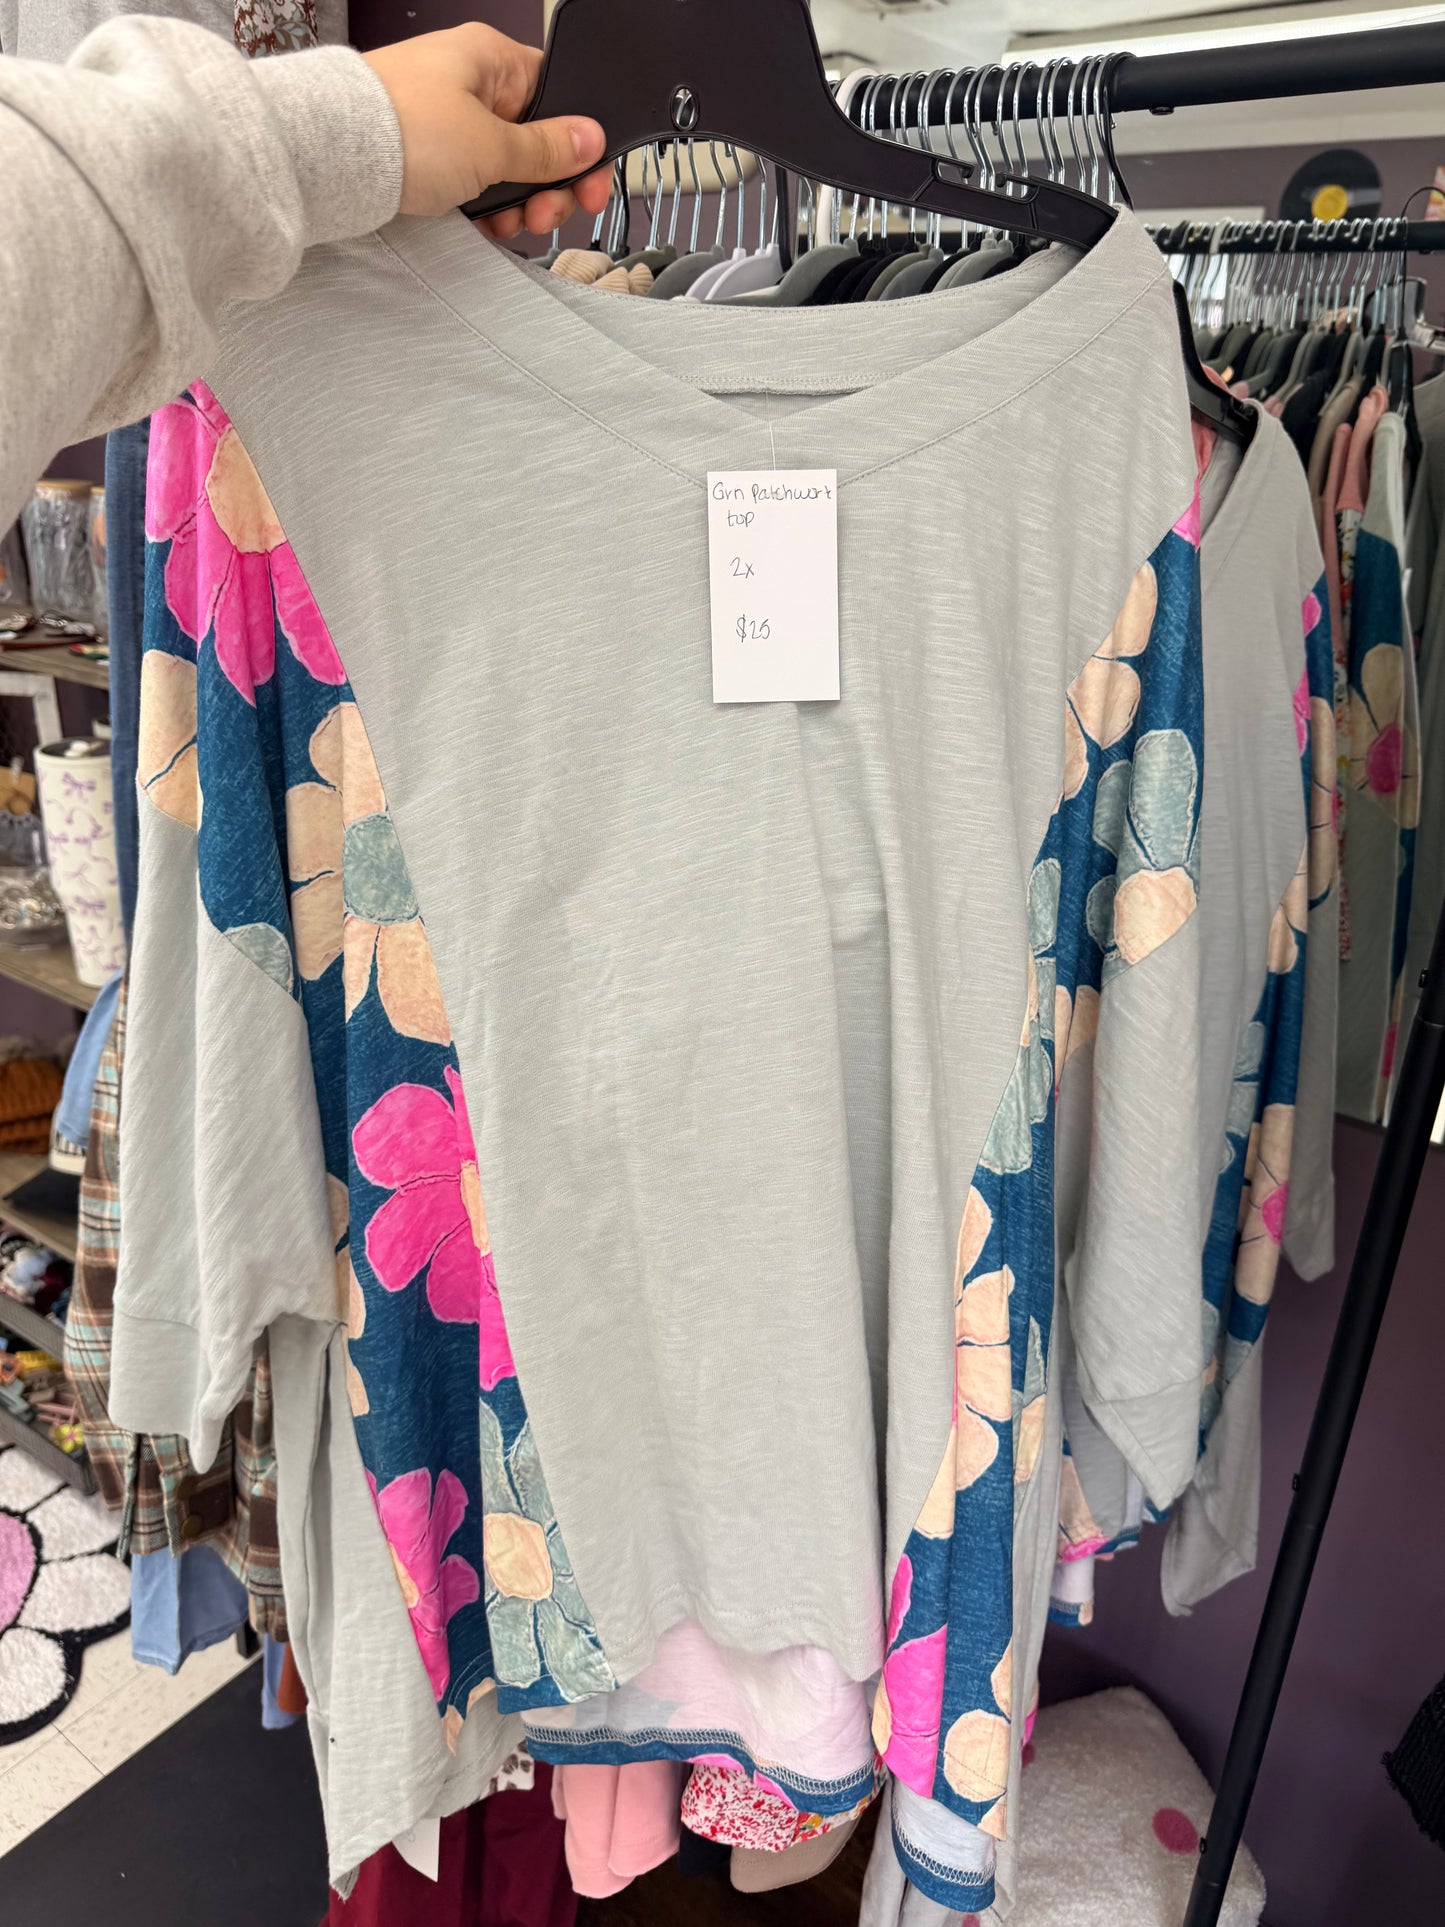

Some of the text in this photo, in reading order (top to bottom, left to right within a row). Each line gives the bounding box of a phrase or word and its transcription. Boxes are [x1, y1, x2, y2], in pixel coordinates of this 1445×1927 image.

[712, 481, 745, 501] Grn
[727, 510, 755, 528] top
[735, 613, 771, 643] $25
